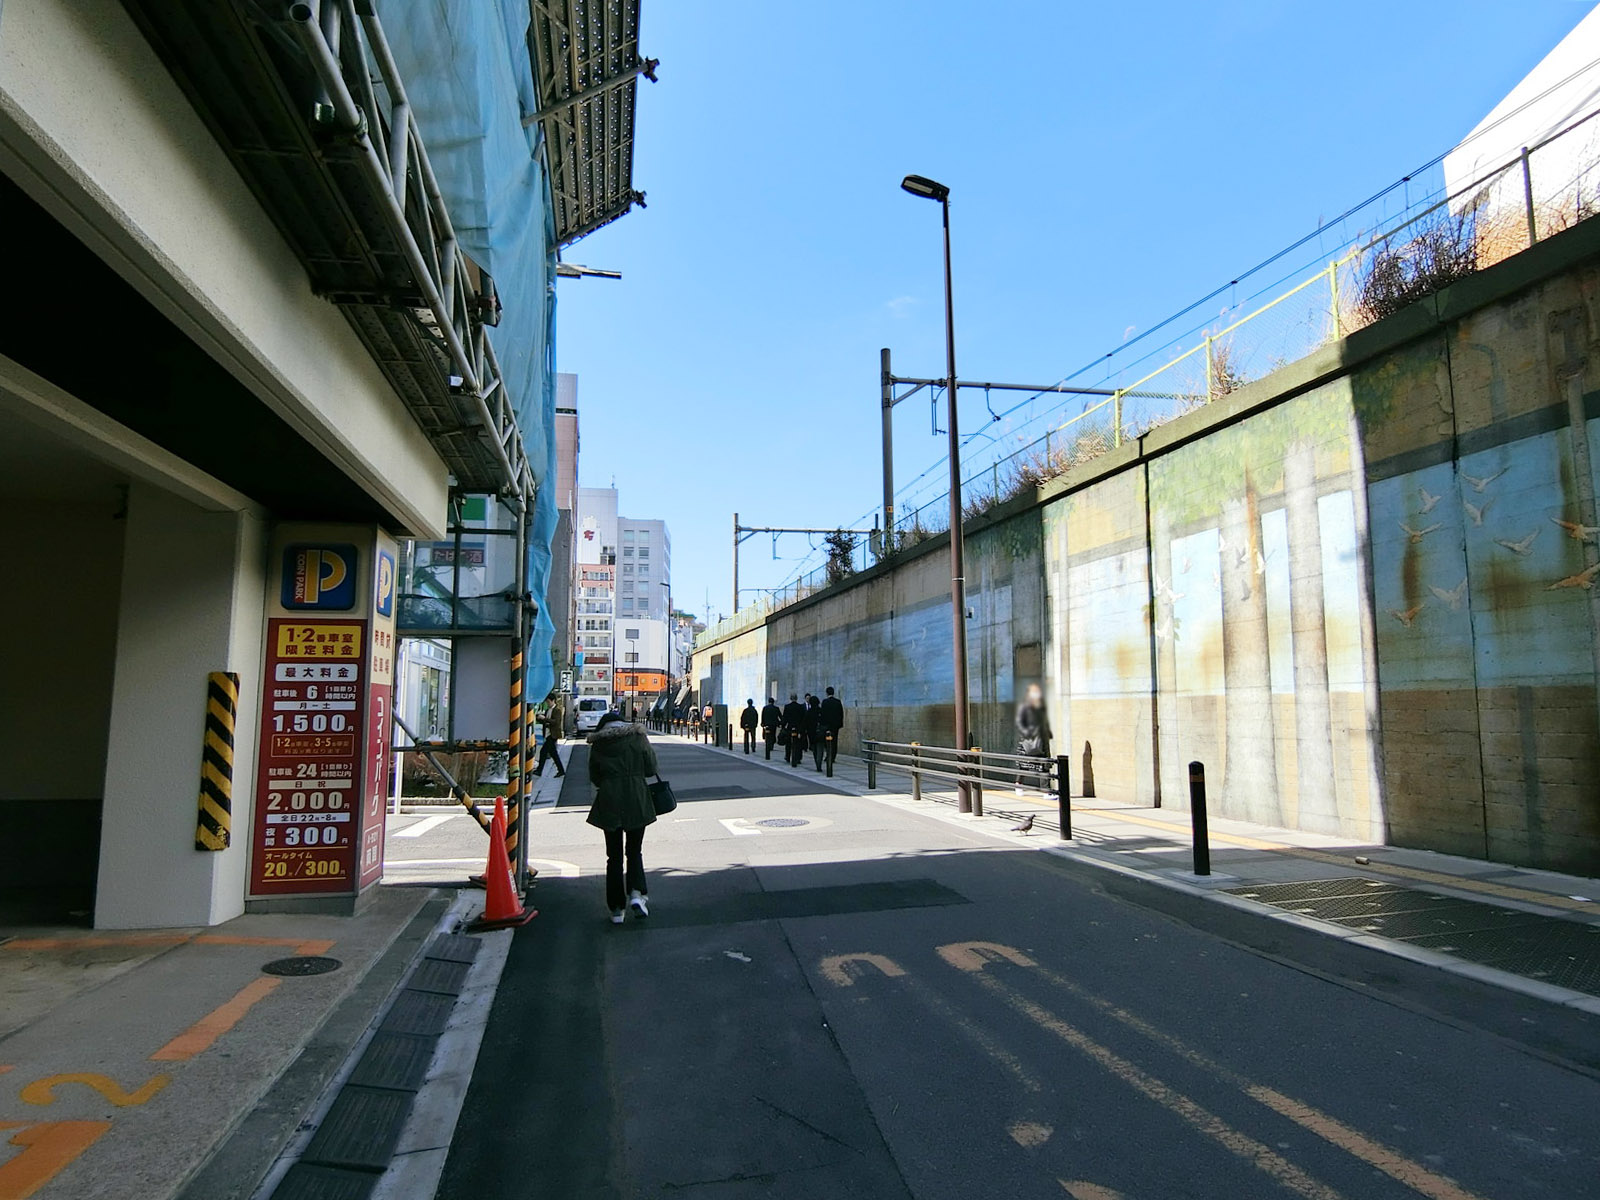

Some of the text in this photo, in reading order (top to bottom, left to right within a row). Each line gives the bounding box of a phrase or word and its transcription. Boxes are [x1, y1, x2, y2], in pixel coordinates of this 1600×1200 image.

[295, 553, 306, 599] COIN PARK
[304, 549, 347, 604] P
[285, 645, 353, 655] 限定料金
[285, 667, 350, 678] 最大料金
[273, 685, 318, 700] 駐車後 6
[325, 692, 355, 700] 時間以内
[273, 714, 354, 732] 1,500円
[370, 696, 384, 817] コインパーク
[268, 763, 317, 778] 駐車後 24
[320, 770, 352, 778] 時間以内
[267, 791, 350, 811] 2,000円
[265, 827, 276, 846] 夜間
[265, 852, 313, 860] オールタイム
